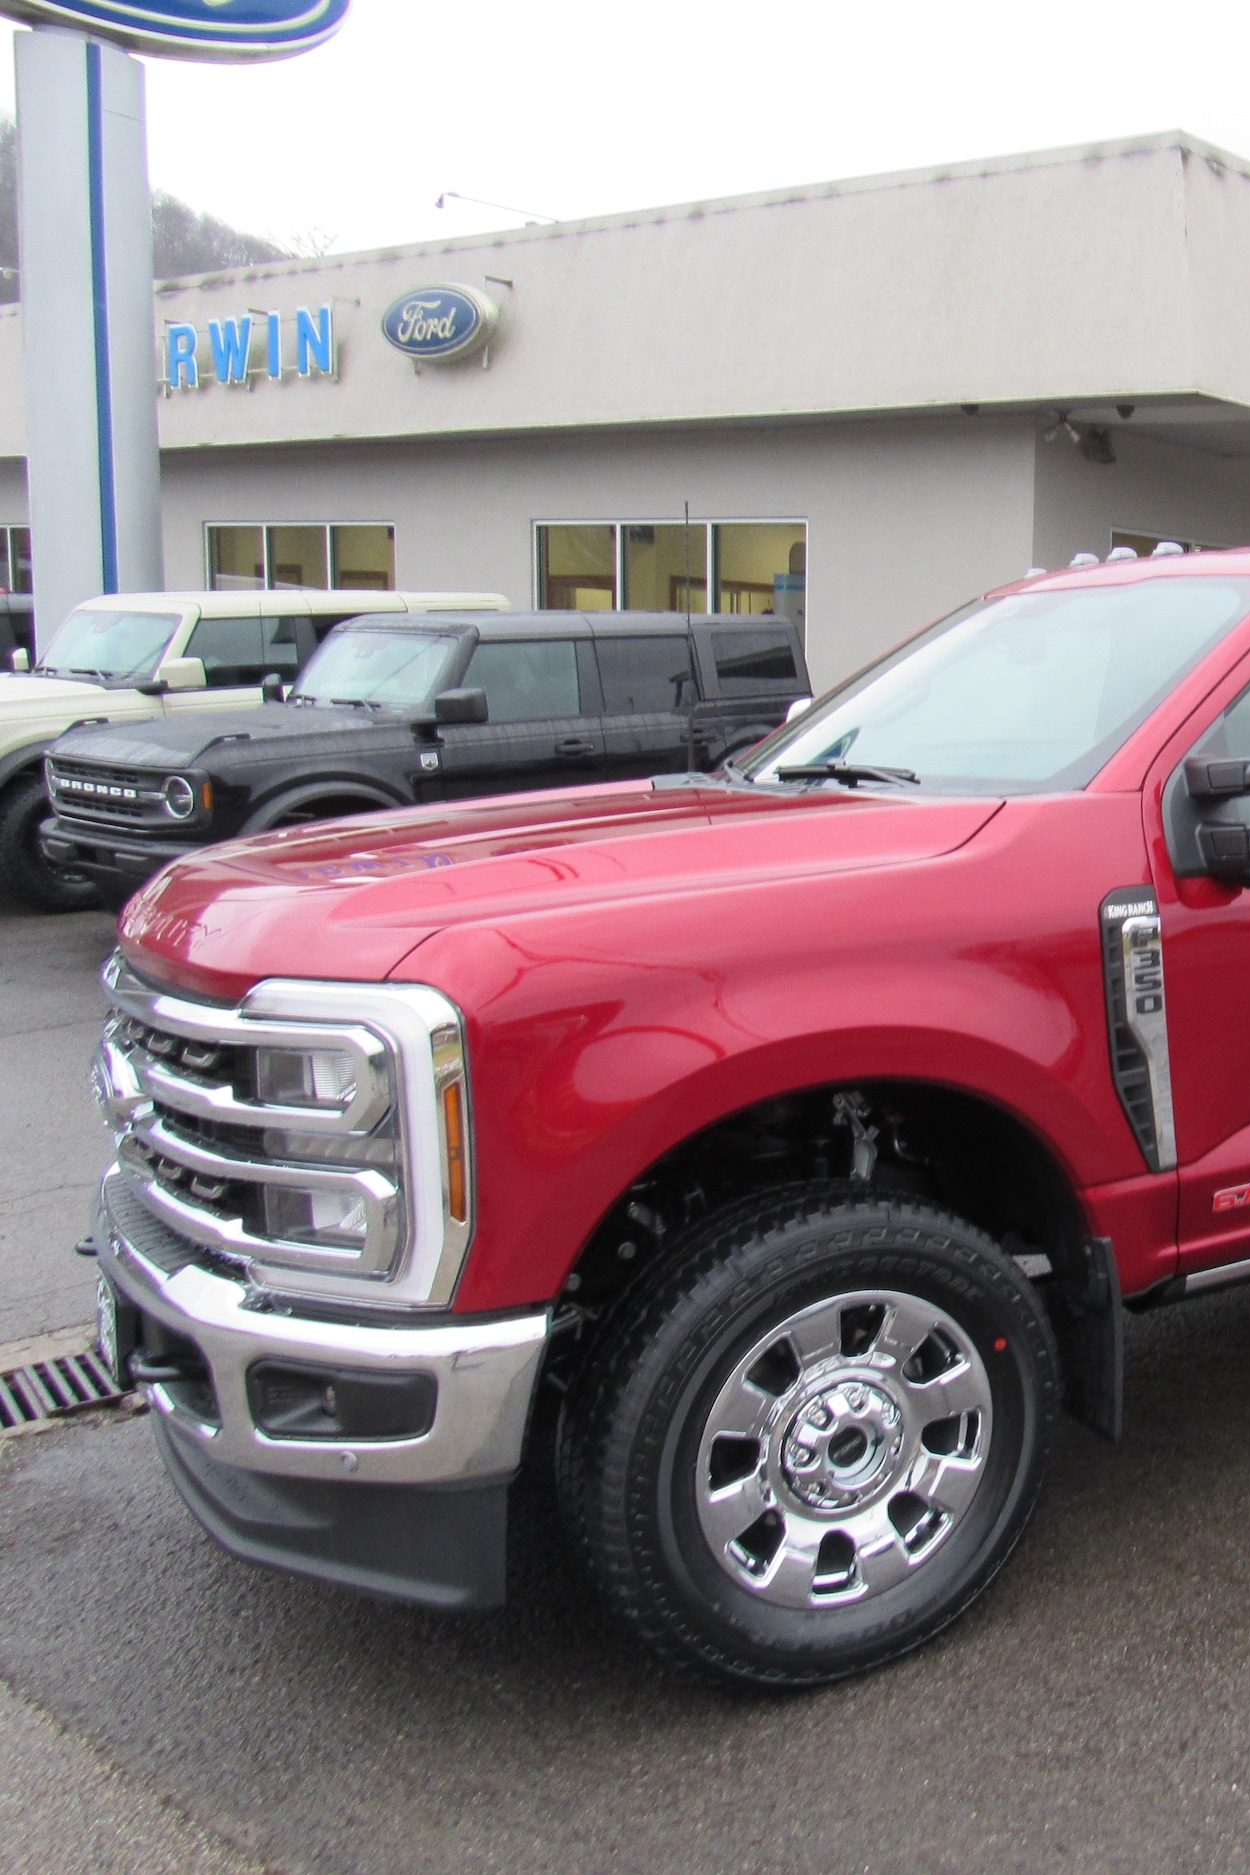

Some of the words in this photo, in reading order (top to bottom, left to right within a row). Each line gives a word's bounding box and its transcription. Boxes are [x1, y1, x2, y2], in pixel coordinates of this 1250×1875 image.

[398, 299, 457, 342] Ford
[60, 778, 137, 798] BRONCO
[1107, 903, 1128, 919] KING
[1127, 900, 1154, 917] RANCH
